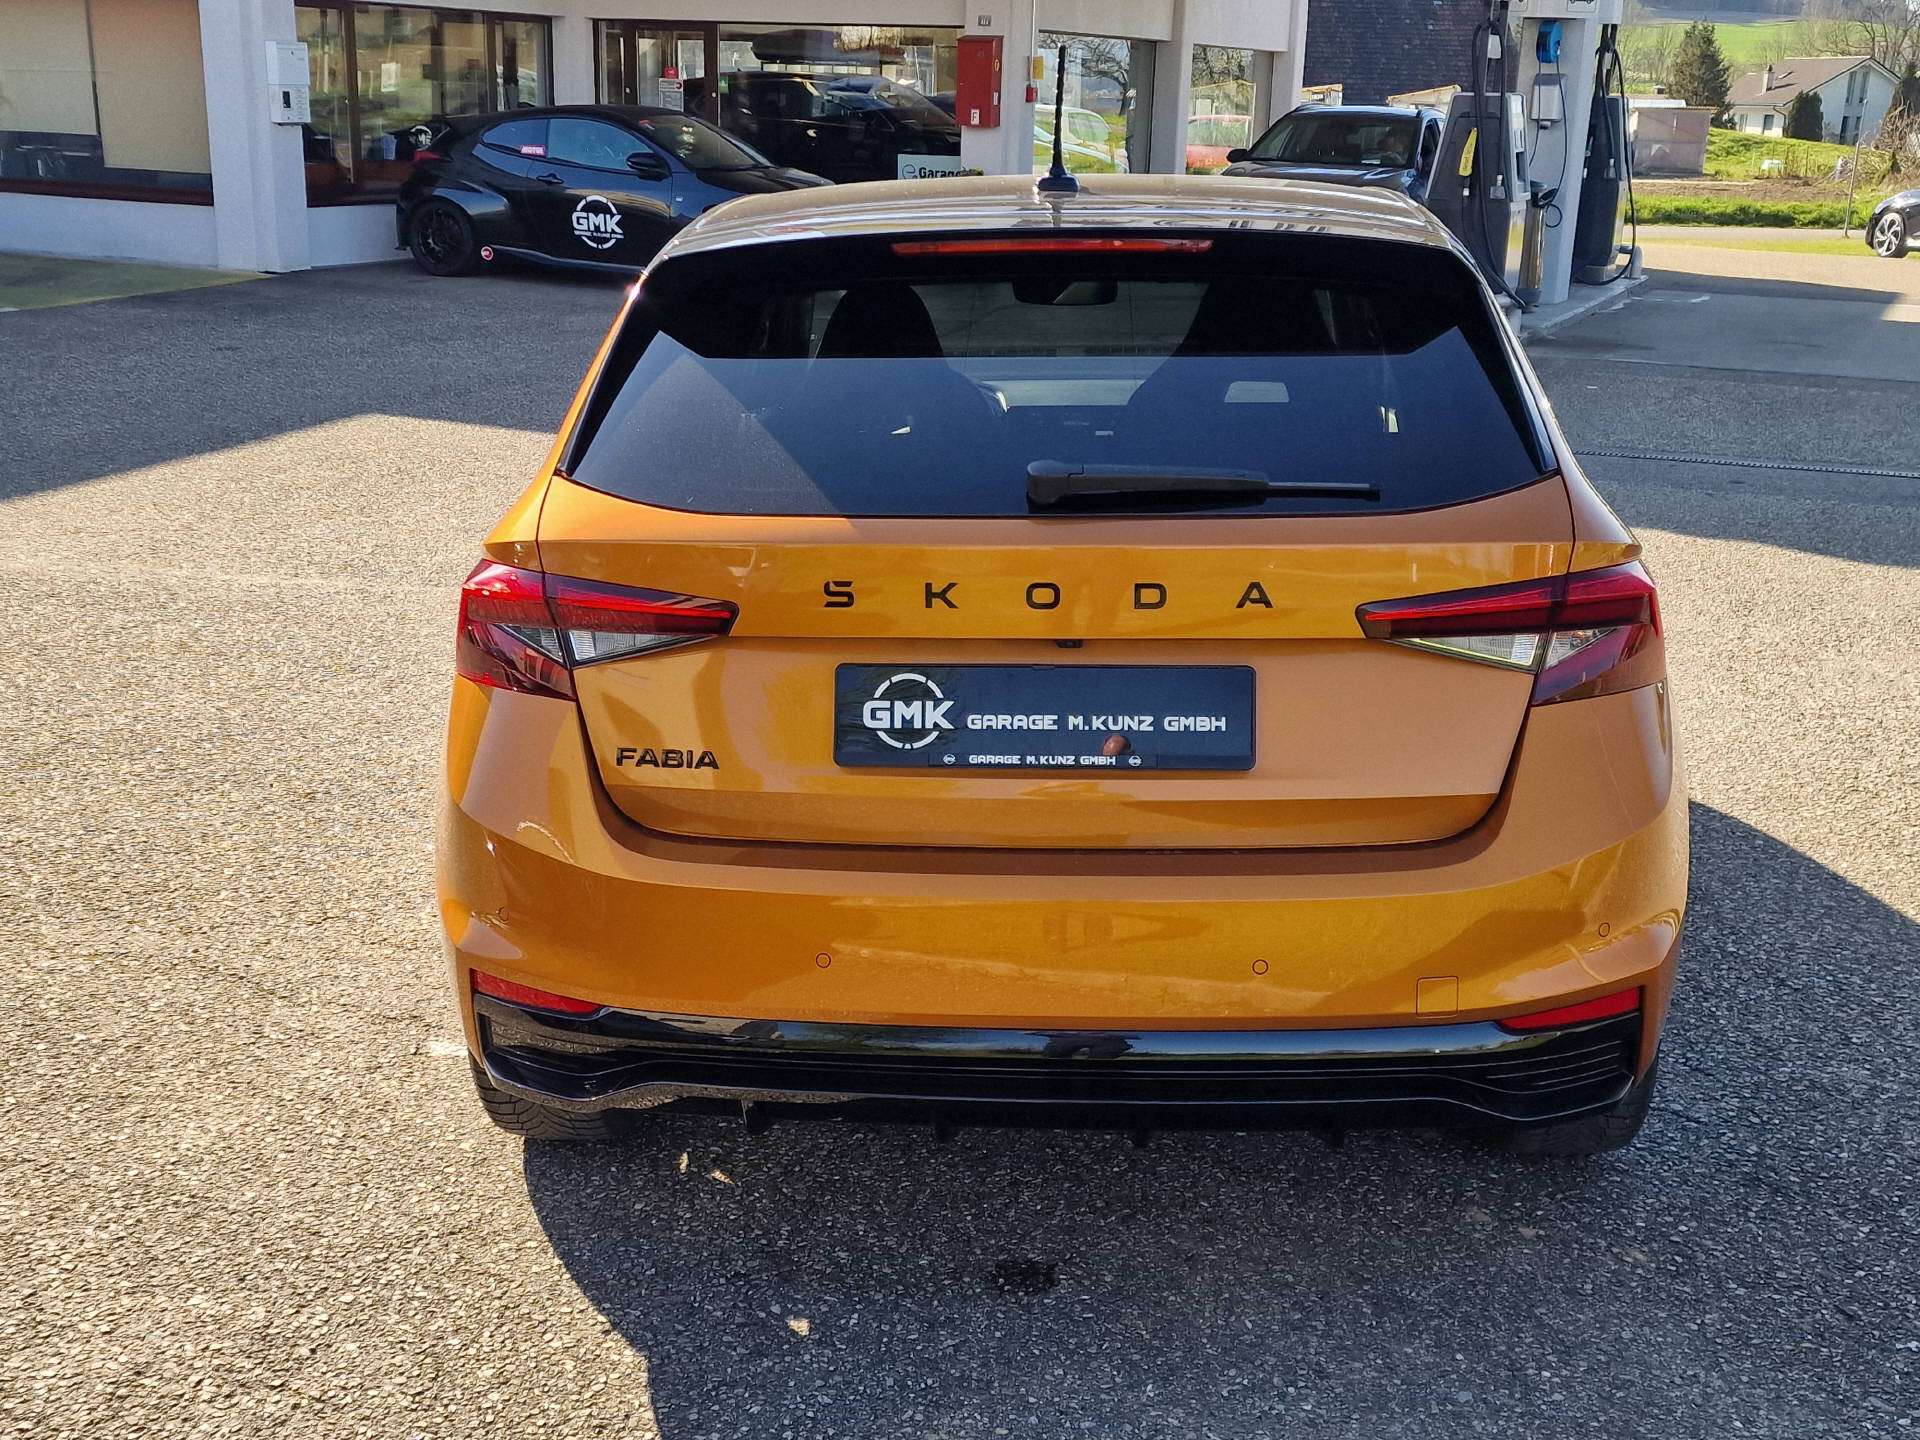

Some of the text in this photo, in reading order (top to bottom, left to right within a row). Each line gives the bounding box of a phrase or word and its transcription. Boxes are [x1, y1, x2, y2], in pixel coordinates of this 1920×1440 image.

[572, 212, 624, 234] GMK
[823, 580, 1274, 609] SKODA
[863, 701, 955, 729] GMK
[967, 715, 1227, 732] GARAGE M.KUNZ GMBH
[616, 747, 720, 770] FABIA
[968, 754, 1022, 765] GARAGE
[1026, 755, 1075, 765] M.KUNZ
[1080, 755, 1116, 766] GMBH
